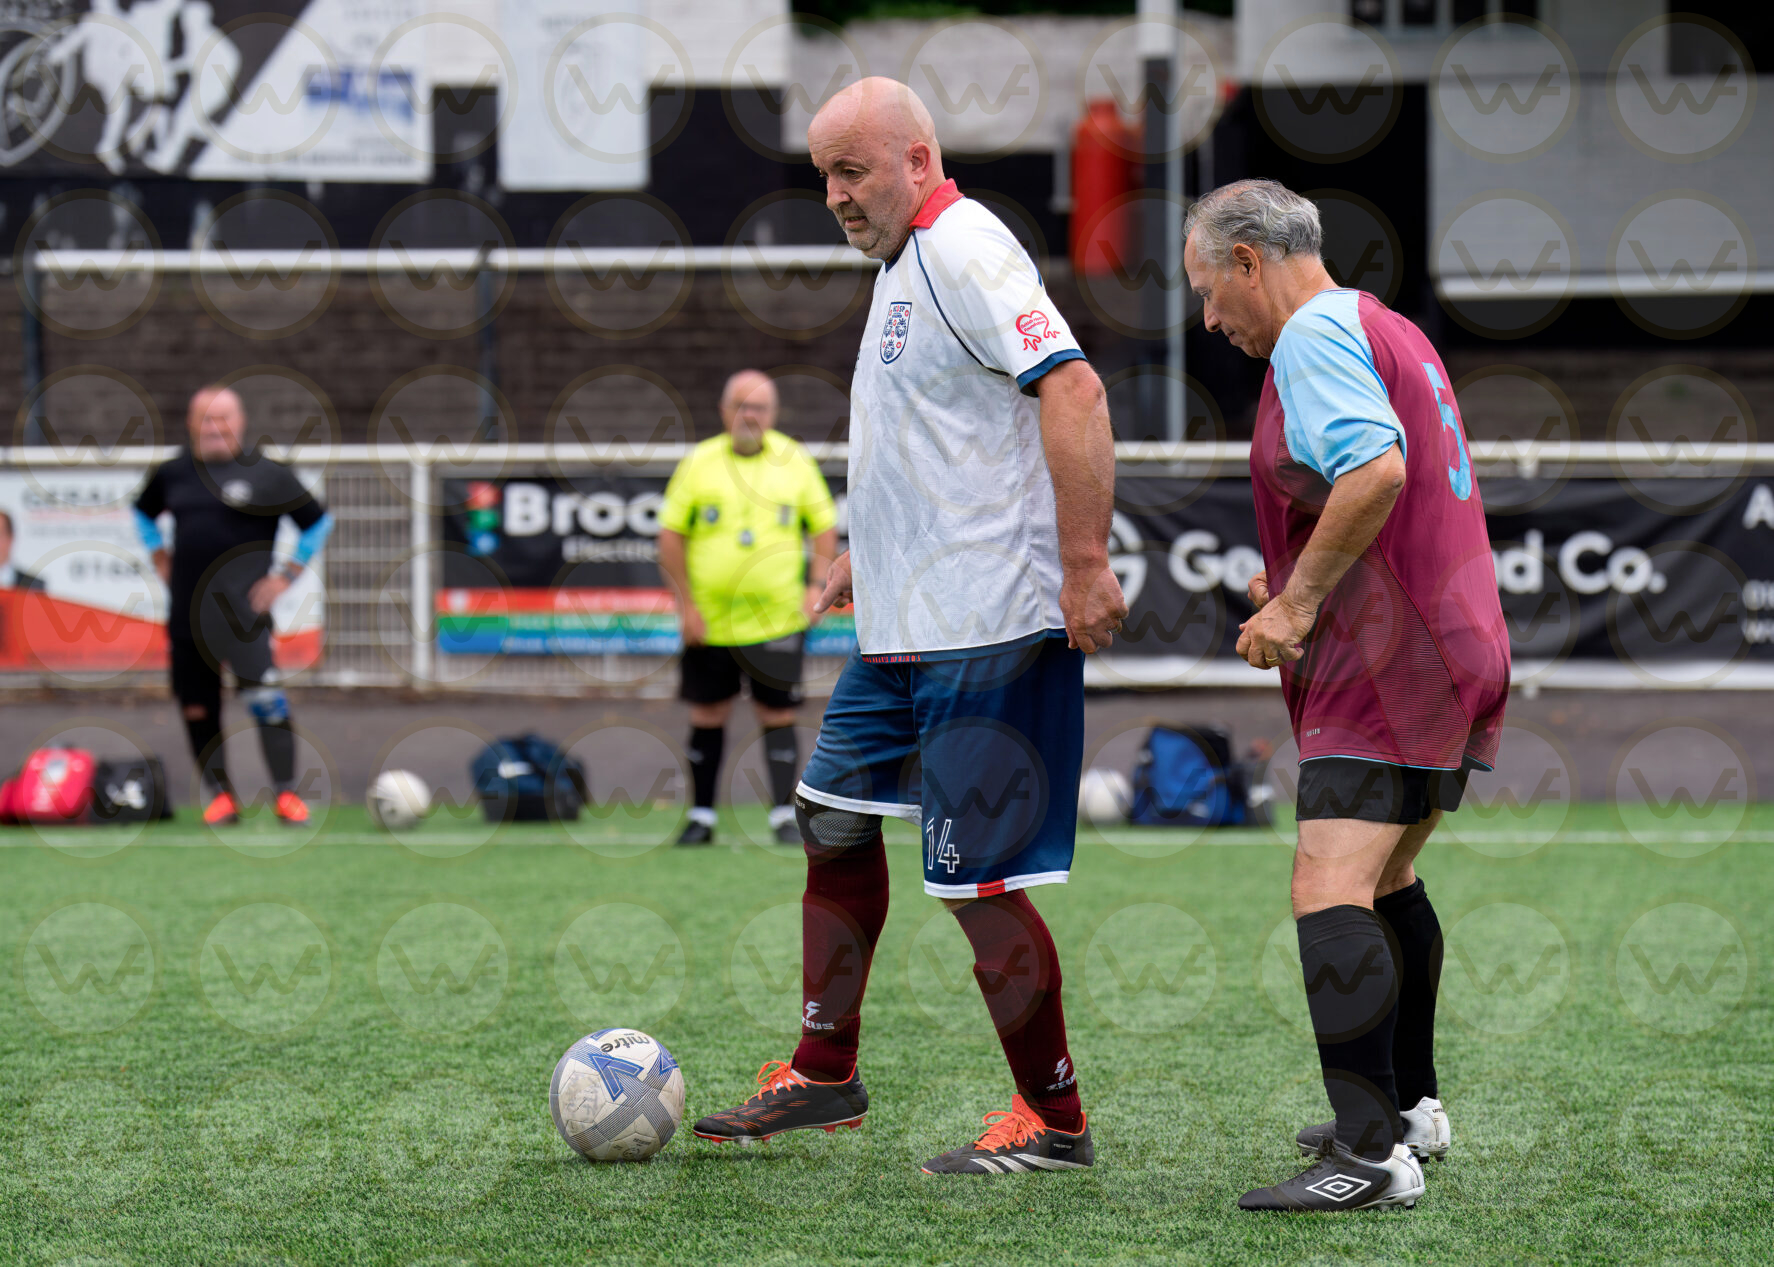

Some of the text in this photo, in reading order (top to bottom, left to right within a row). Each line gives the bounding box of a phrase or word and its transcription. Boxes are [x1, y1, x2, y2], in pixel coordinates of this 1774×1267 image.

[1421, 361, 1472, 501] 5
[1558, 530, 1667, 595] Co.
[926, 817, 960, 873] 14
[600, 1035, 651, 1054] mitre
